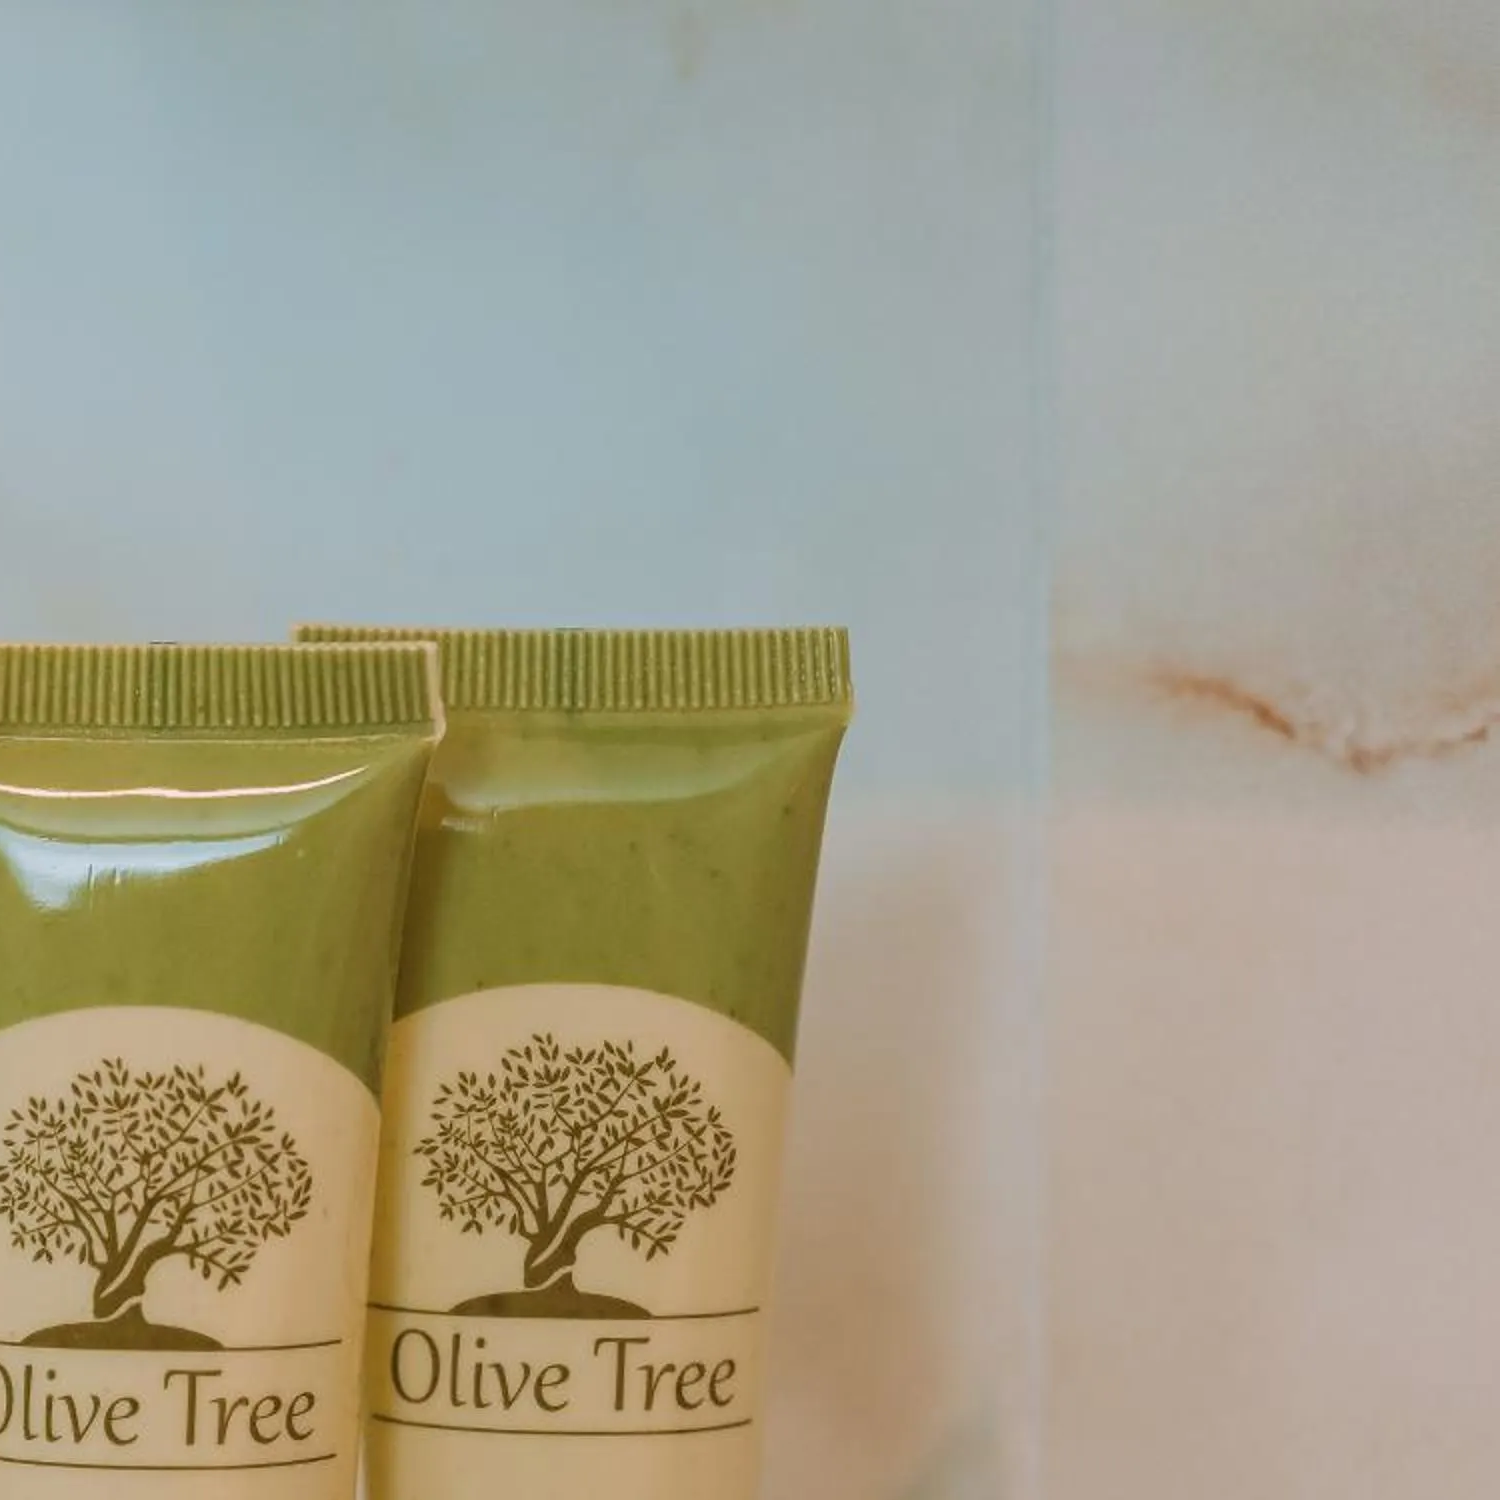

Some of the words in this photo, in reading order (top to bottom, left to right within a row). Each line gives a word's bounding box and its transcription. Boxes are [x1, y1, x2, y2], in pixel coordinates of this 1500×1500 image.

[163, 1368, 317, 1447] Tree
[389, 1328, 571, 1413] Olive
[593, 1336, 737, 1412] Tree
